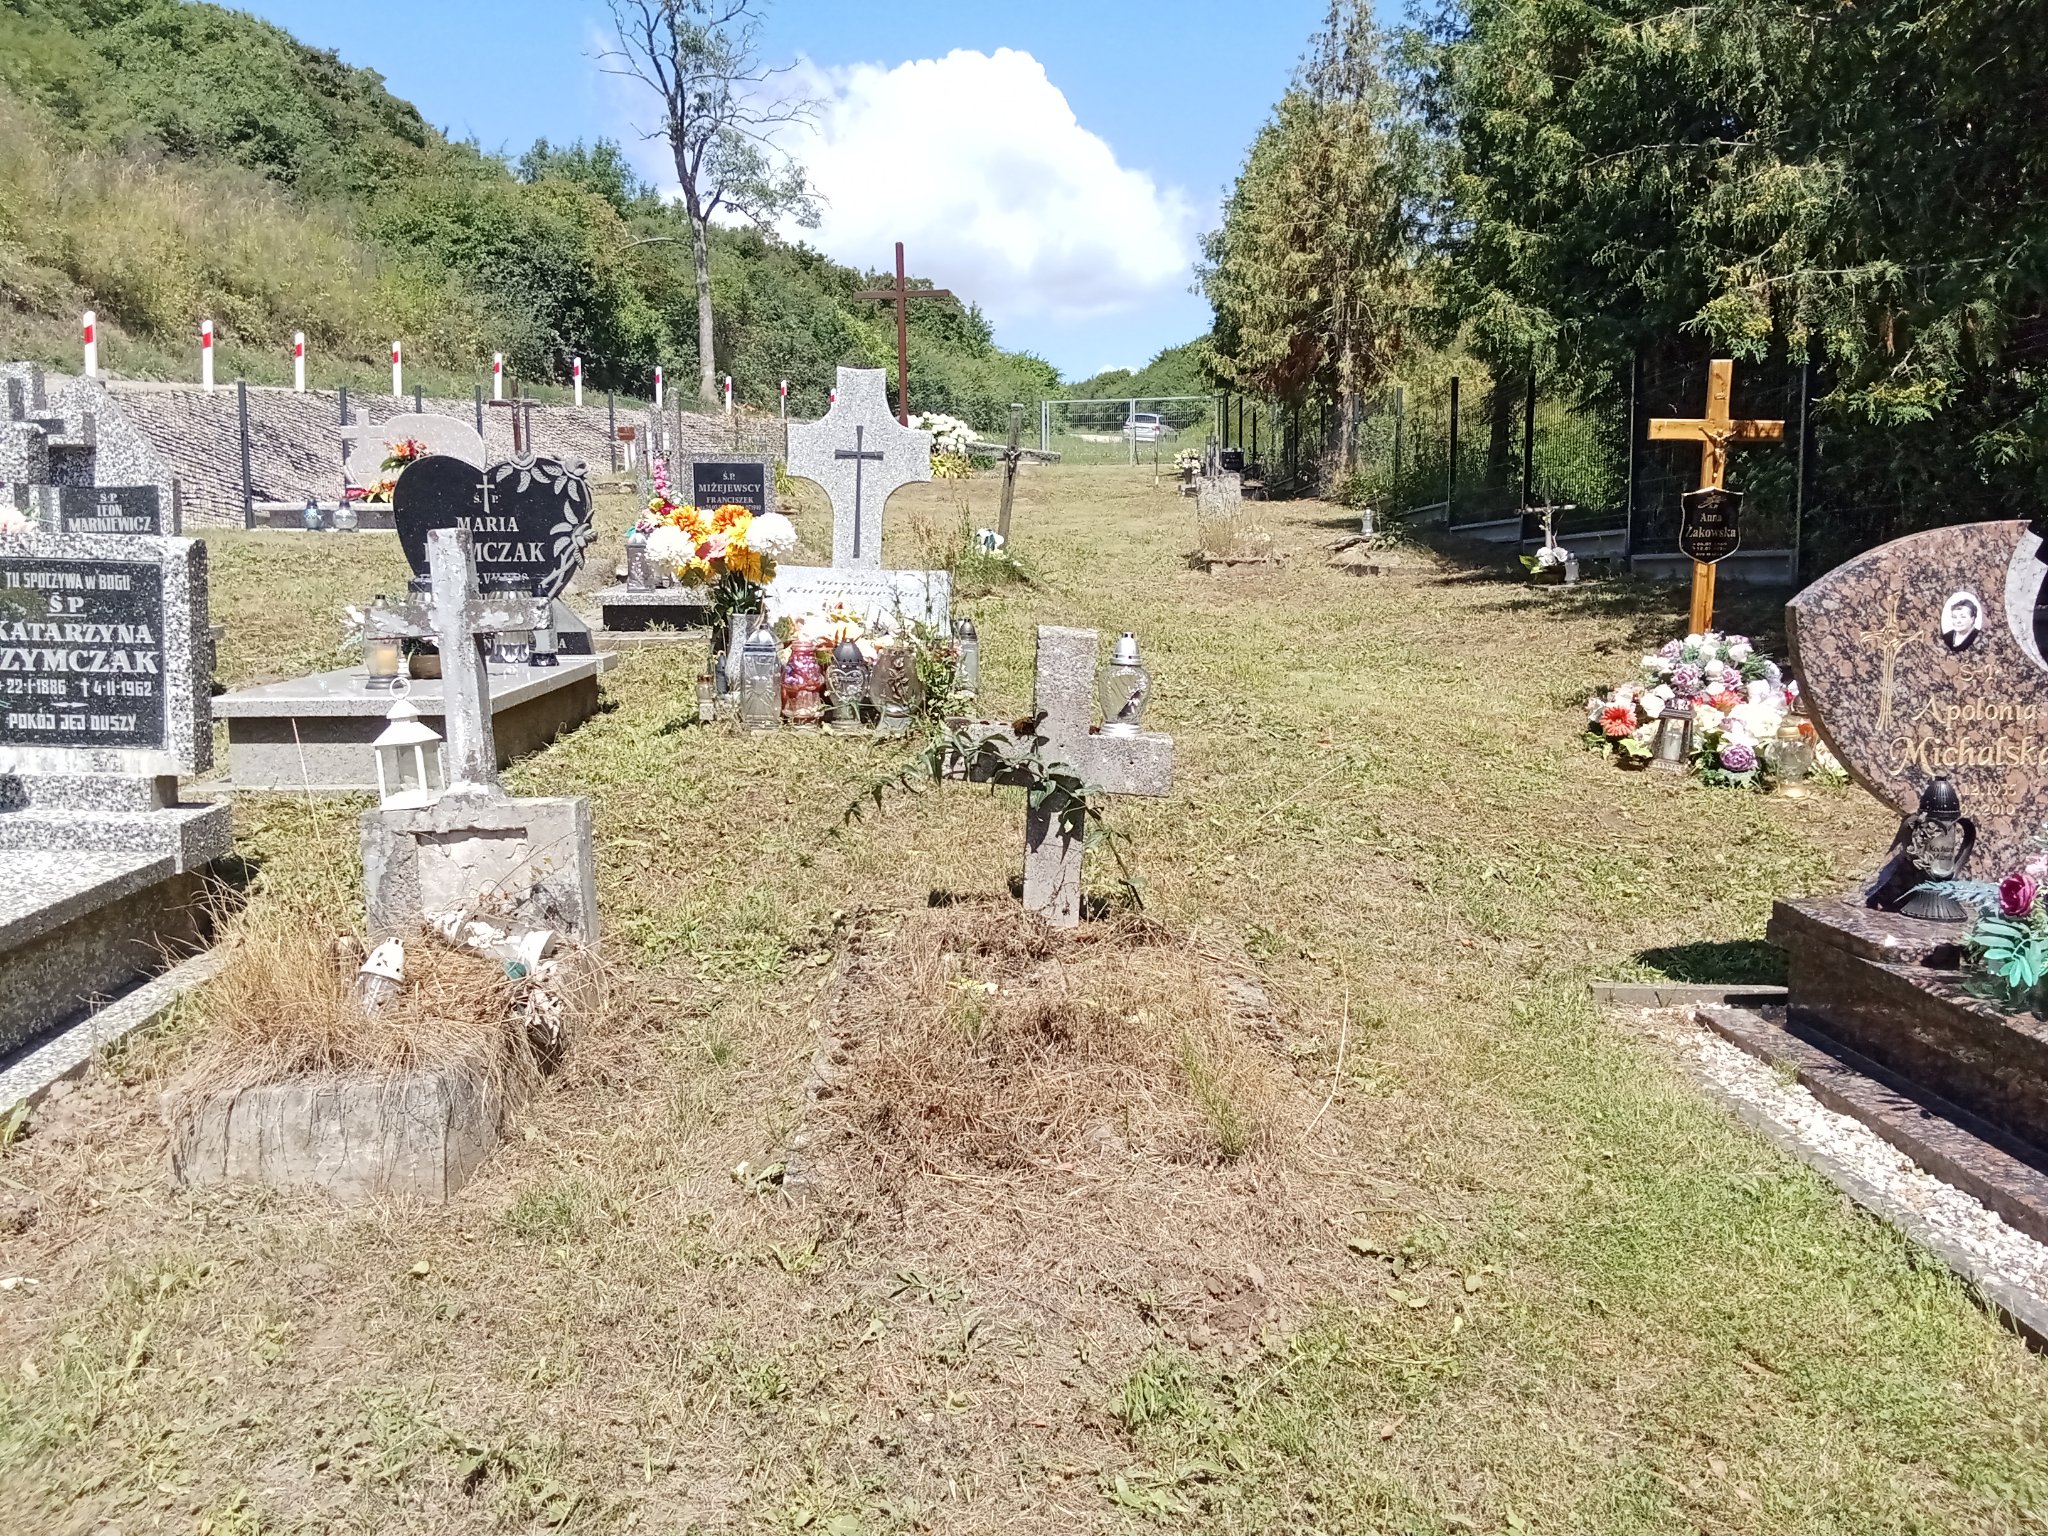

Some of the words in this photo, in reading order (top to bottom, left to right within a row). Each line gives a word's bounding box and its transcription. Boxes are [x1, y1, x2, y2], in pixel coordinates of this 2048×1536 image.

[698, 482, 761, 494] MIŻEJEWSCY
[97, 504, 122, 516] LEON
[1700, 513, 1722, 522] Anna
[68, 516, 152, 532] MARKIEWICZ
[456, 516, 519, 532] MARIA
[1685, 524, 1736, 537] Żakowska
[6, 571, 19, 587] TU
[24, 572, 83, 589] SPOCZYWA
[99, 574, 131, 590] BOGU
[9, 708, 55, 729] POKÓJ
[60, 714, 86, 730] JEJ
[90, 713, 136, 731] DUSZY
[1911, 697, 2037, 731] Apolonia
